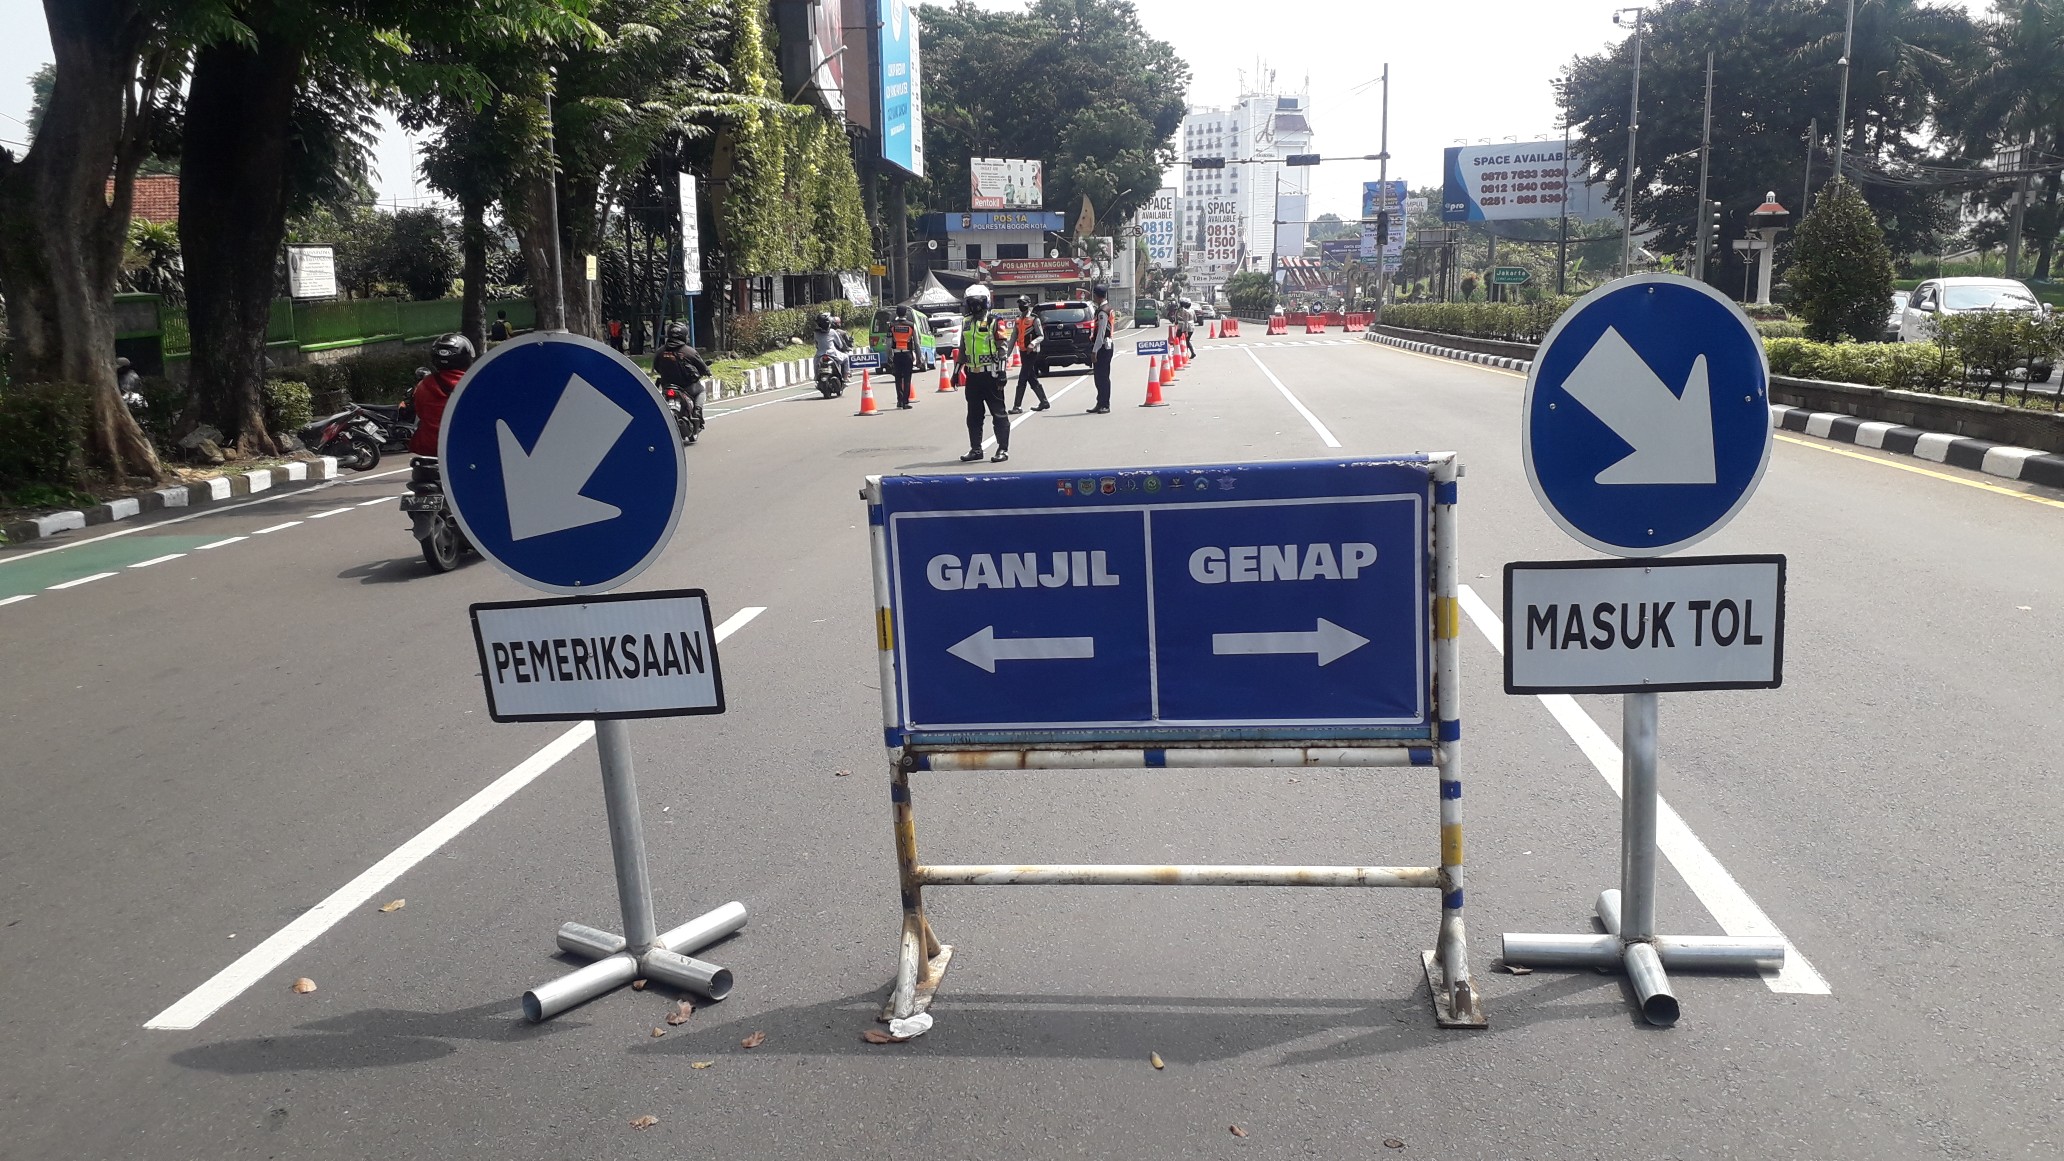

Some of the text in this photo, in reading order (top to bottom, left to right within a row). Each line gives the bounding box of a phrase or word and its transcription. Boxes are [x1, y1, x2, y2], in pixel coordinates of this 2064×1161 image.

[1473, 155, 1511, 166] SPACE
[974, 198, 1000, 207] Rentokil
[1141, 197, 1173, 210] SPACE
[1207, 202, 1237, 215] SPACE
[993, 214, 1027, 223] POS 1A
[1141, 211, 1172, 219] AVAILABLE
[1142, 221, 1174, 233] 0818
[1207, 224, 1236, 236] 0813
[1207, 237, 1236, 248] 1500
[1207, 248, 1236, 260] 5151
[1016, 261, 1040, 269] LANTAS
[1041, 260, 1070, 268] TANGGUH
[1138, 341, 1166, 349] GENAP
[850, 354, 877, 362] GANJIL
[1188, 542, 1378, 585] GENAP
[926, 549, 1120, 591] GANJIL
[1526, 599, 1764, 651] MASUK TOL
[491, 630, 705, 685] PEMERIKSAAN
